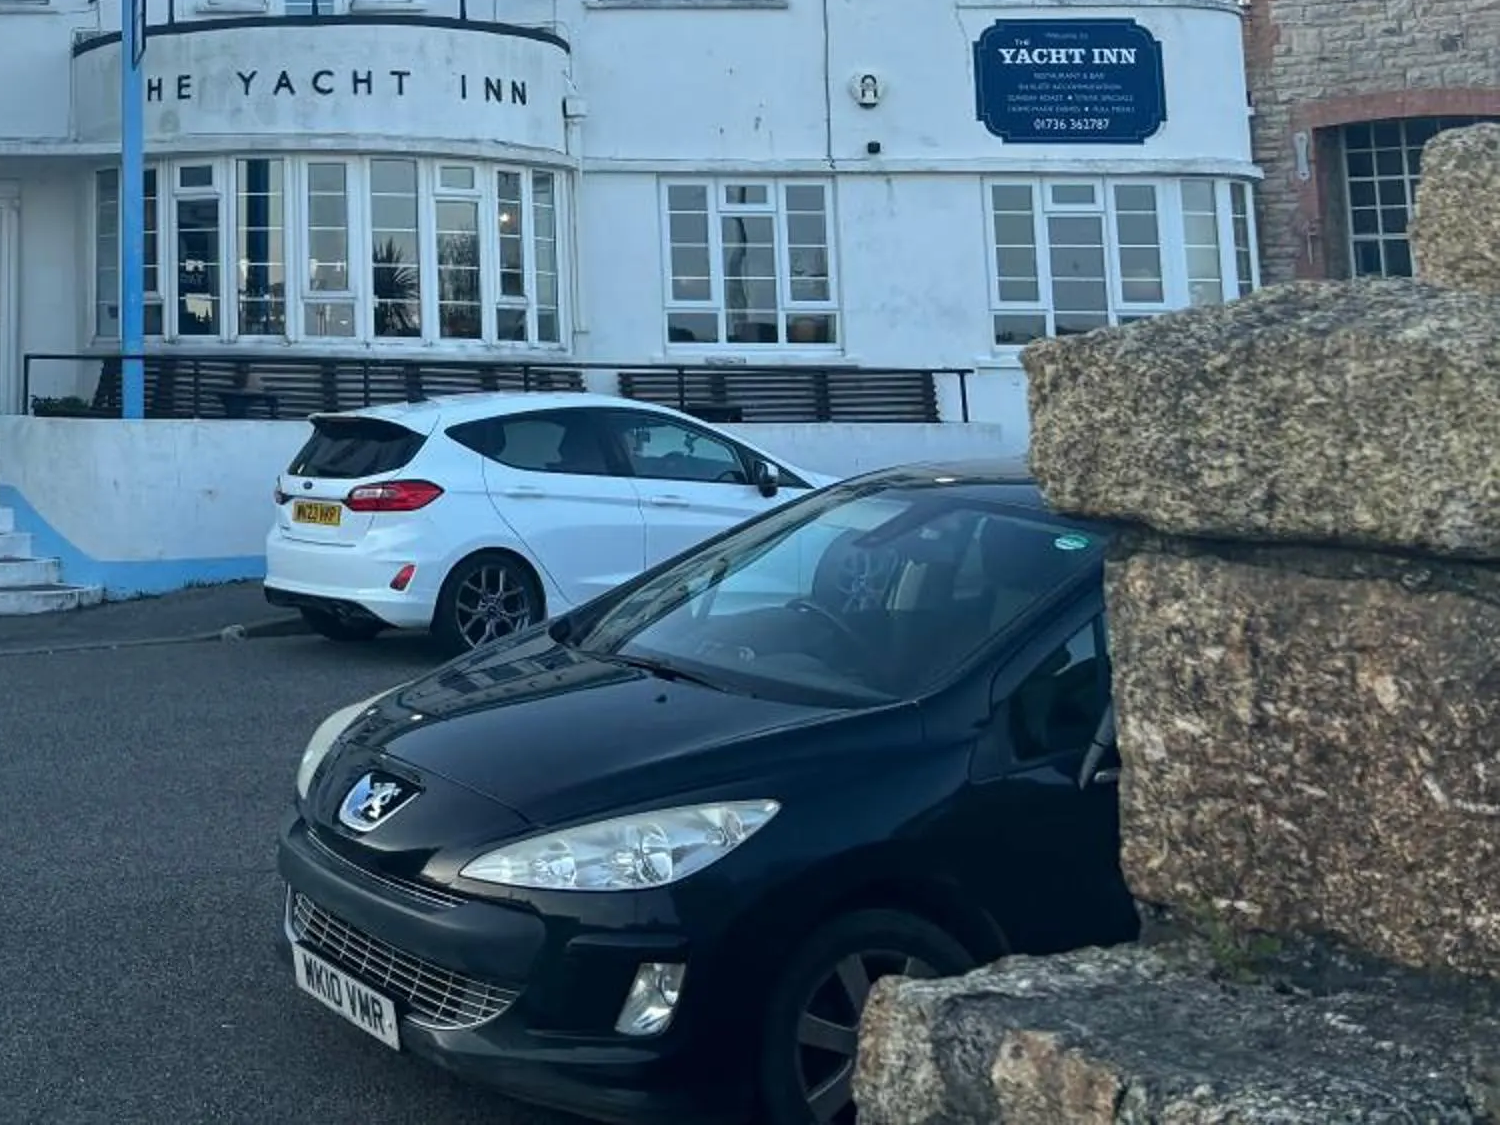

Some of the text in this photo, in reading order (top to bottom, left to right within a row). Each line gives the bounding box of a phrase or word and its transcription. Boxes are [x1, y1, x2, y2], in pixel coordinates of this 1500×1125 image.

[998, 48, 1137, 64] YACHT INN
[147, 70, 528, 105] HE YACHT INN
[1070, 118, 1110, 130] 362787
